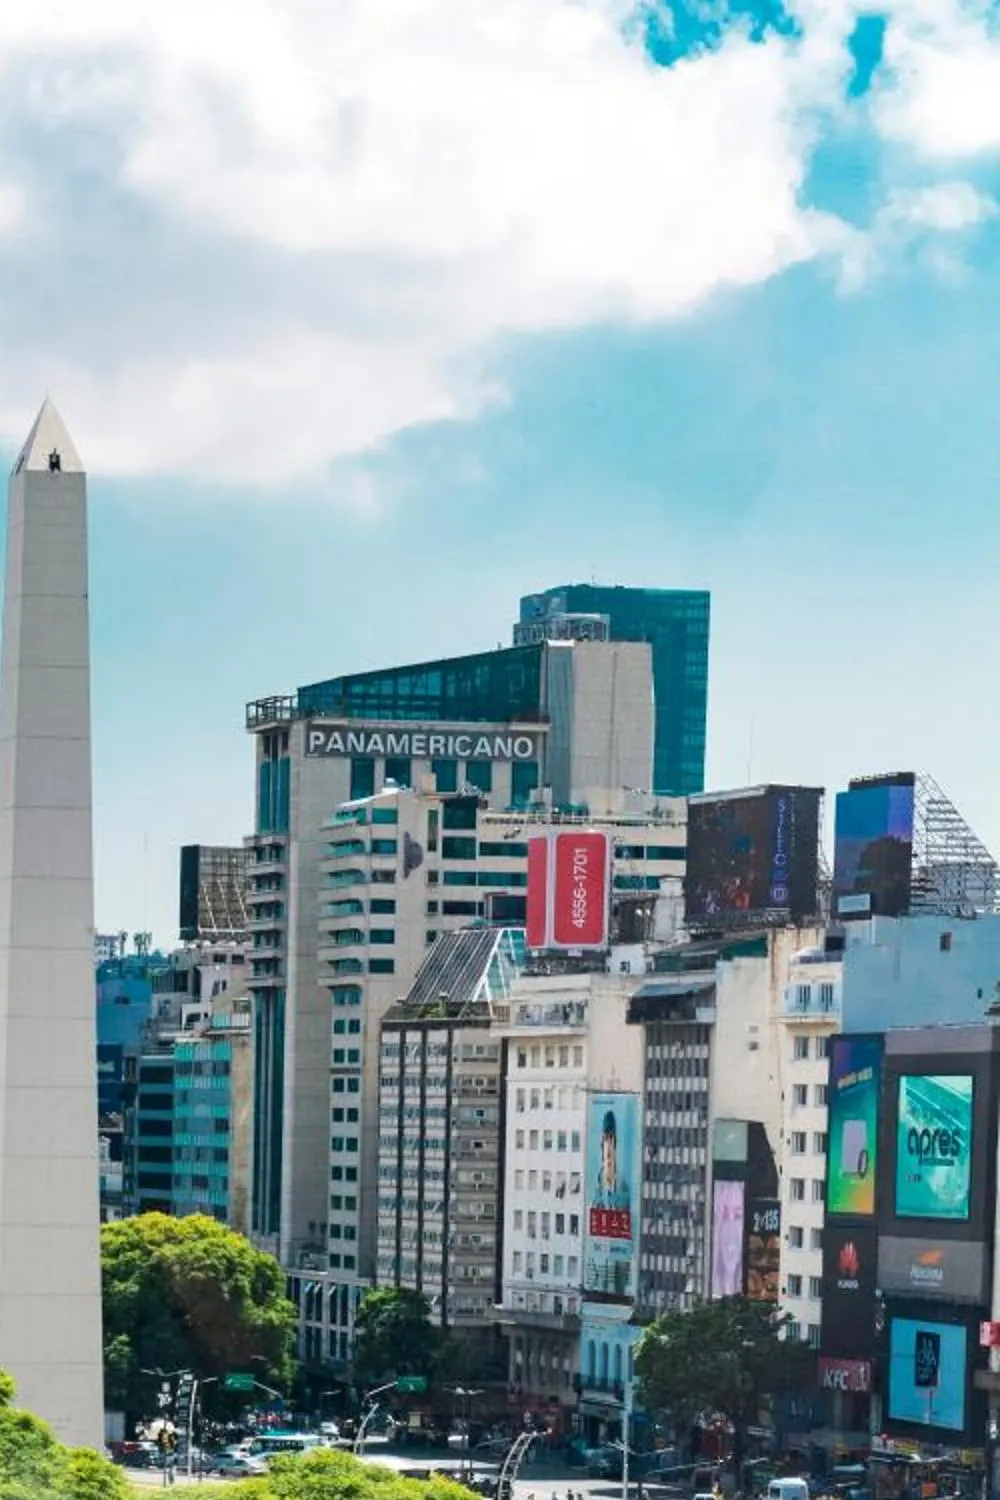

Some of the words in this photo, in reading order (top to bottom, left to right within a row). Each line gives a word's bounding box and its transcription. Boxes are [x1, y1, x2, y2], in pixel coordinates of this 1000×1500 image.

[308, 731, 534, 758] PANAMERICANO
[571, 847, 590, 929] 4556-1701
[824, 1367, 849, 1390] KFC
